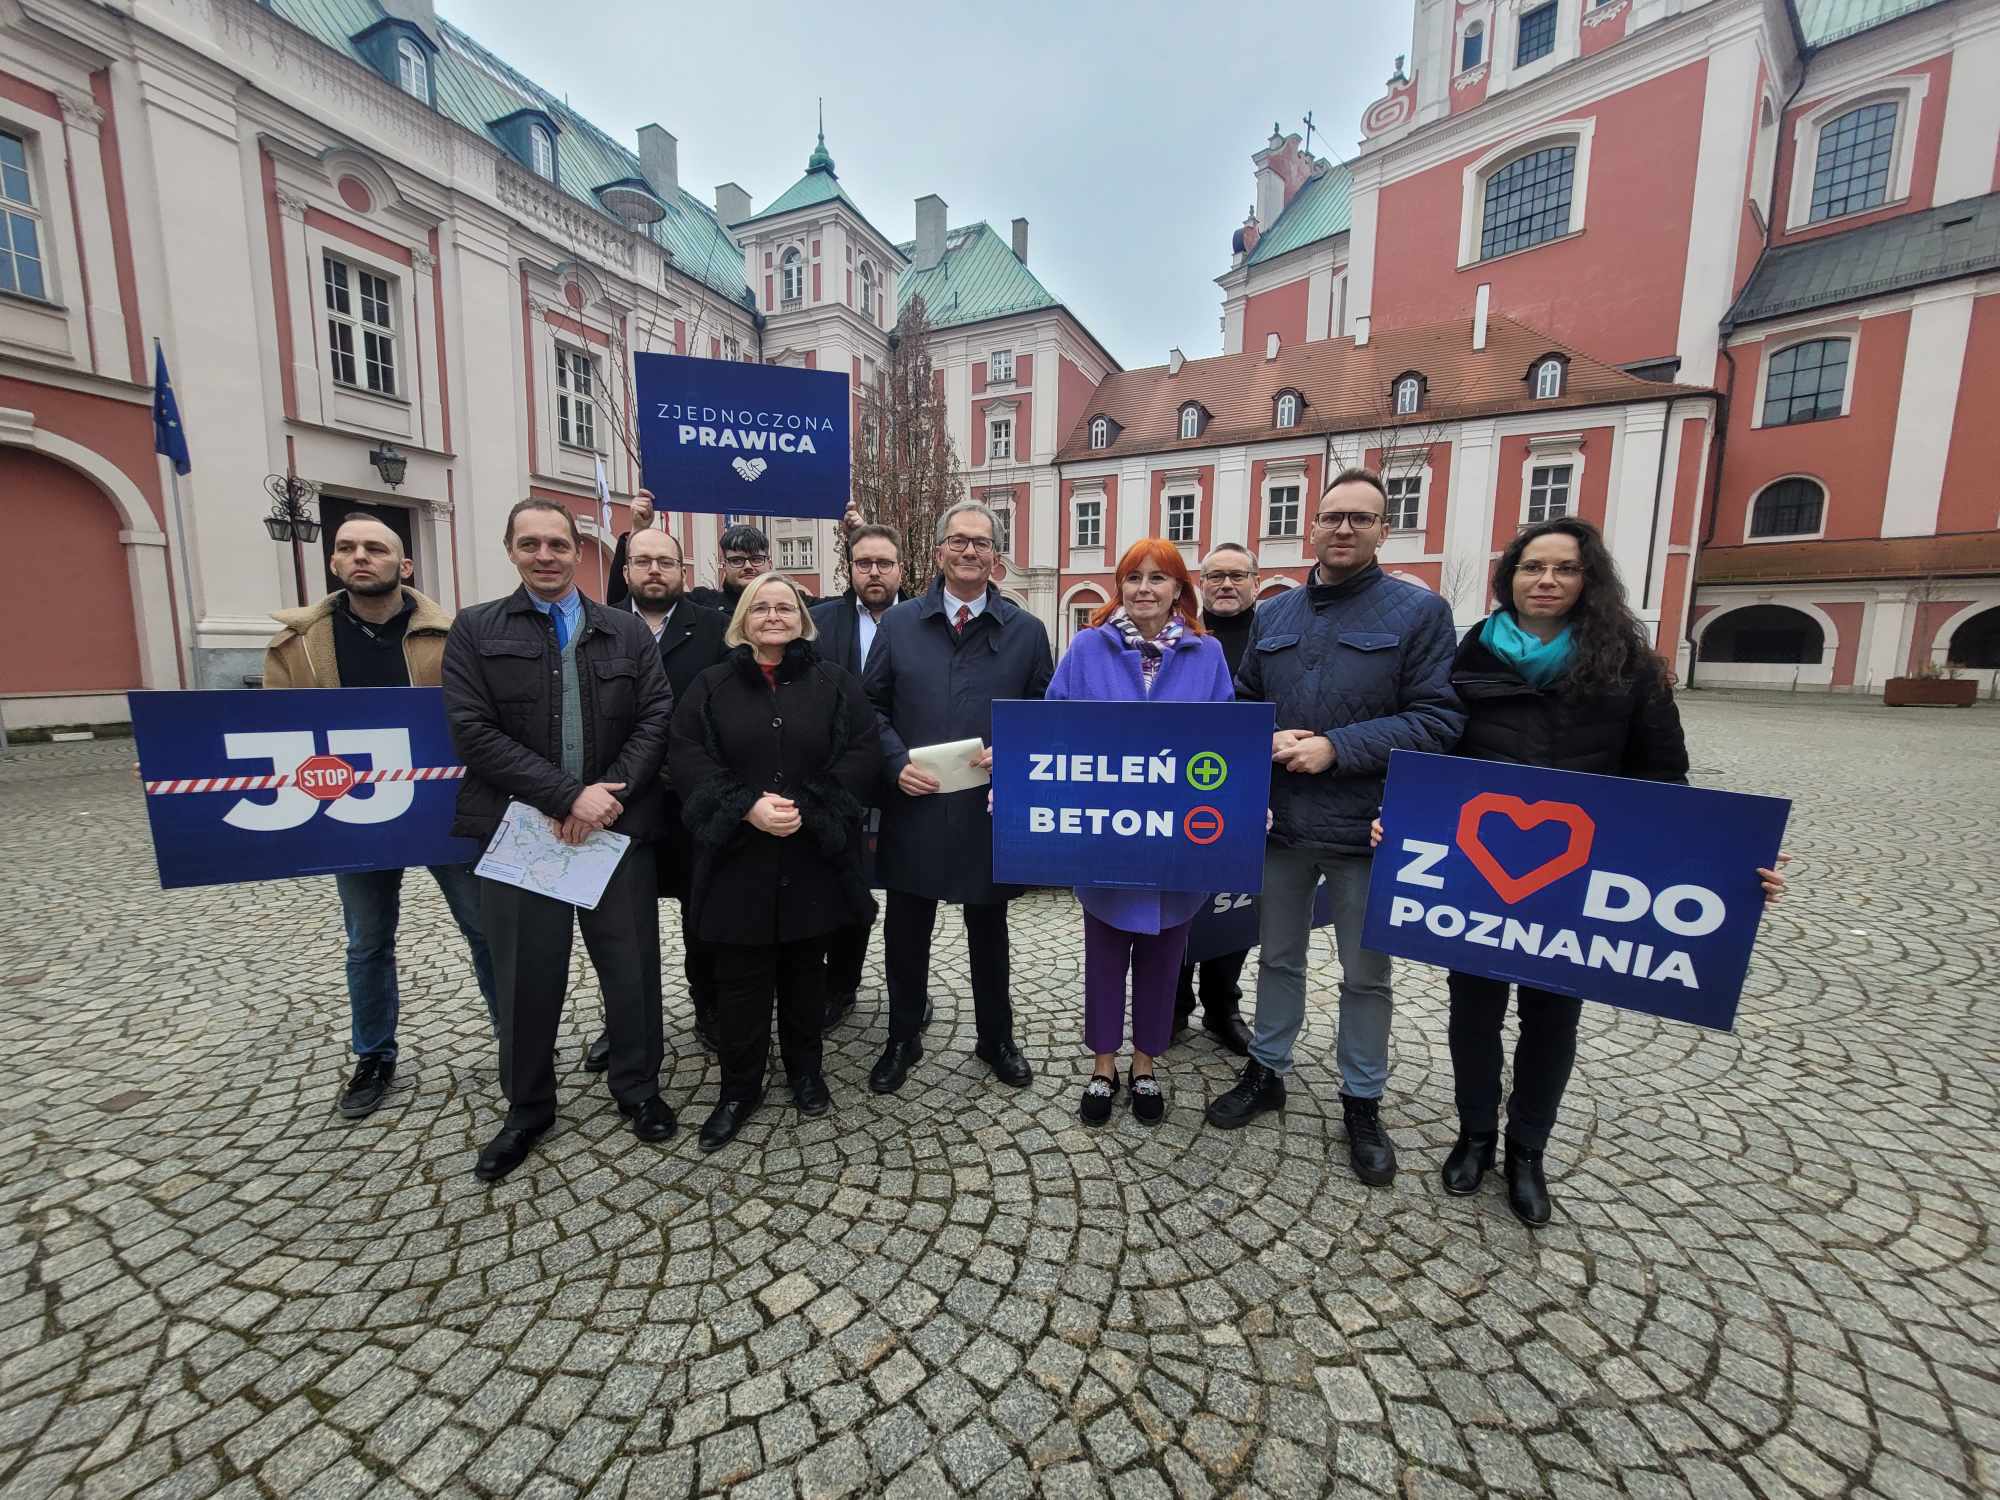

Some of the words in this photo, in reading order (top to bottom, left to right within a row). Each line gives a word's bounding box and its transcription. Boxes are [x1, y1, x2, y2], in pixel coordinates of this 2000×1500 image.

[657, 403, 834, 432] ZJEDNOCZONA
[678, 424, 817, 454] PRAWICA
[222, 727, 415, 832] JJ
[303, 768, 348, 787] STOP
[1028, 748, 1177, 784] ZIELEŃ
[1029, 806, 1174, 837] BETON
[1396, 838, 1450, 890] Z
[1582, 869, 1727, 937] DO
[1389, 895, 1700, 989] POZNANIA
